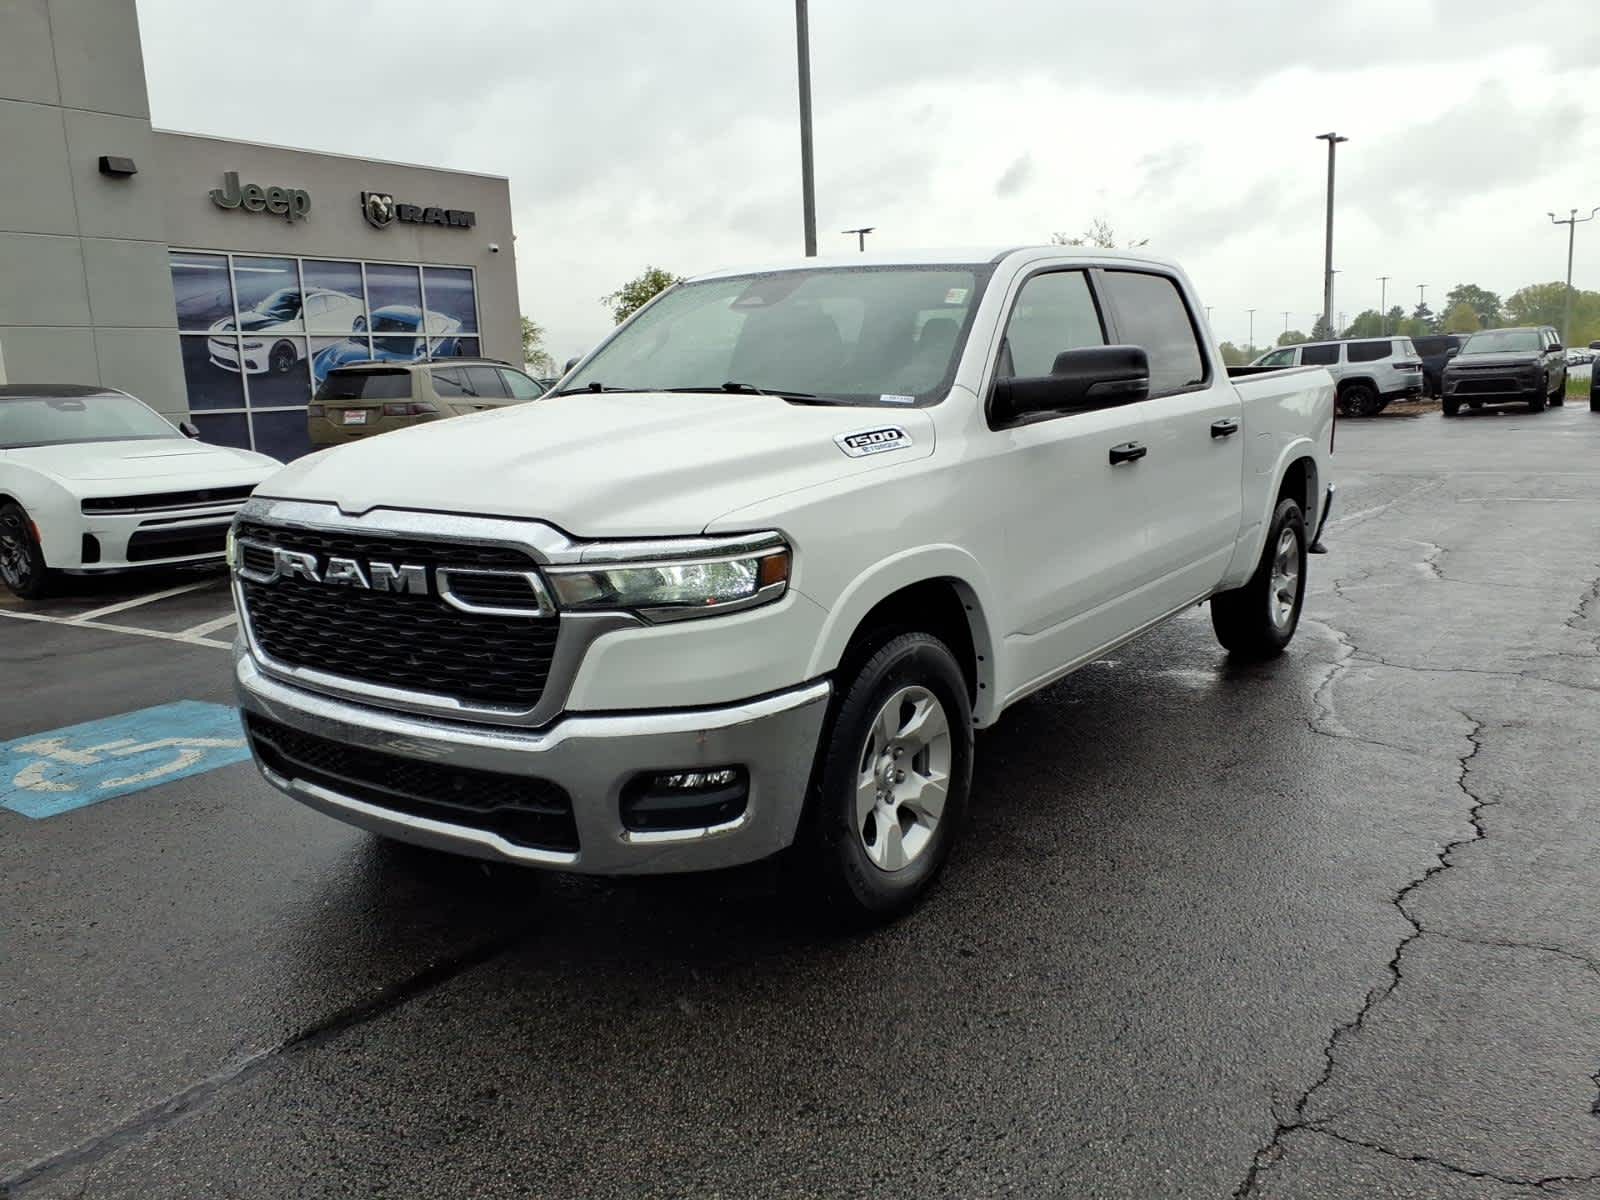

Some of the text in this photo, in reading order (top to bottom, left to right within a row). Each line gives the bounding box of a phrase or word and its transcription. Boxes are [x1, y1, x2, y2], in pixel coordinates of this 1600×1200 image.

[209, 171, 312, 224] Jeep
[396, 203, 476, 228] RAM
[847, 430, 899, 448] 1500
[273, 548, 428, 595] RAM
